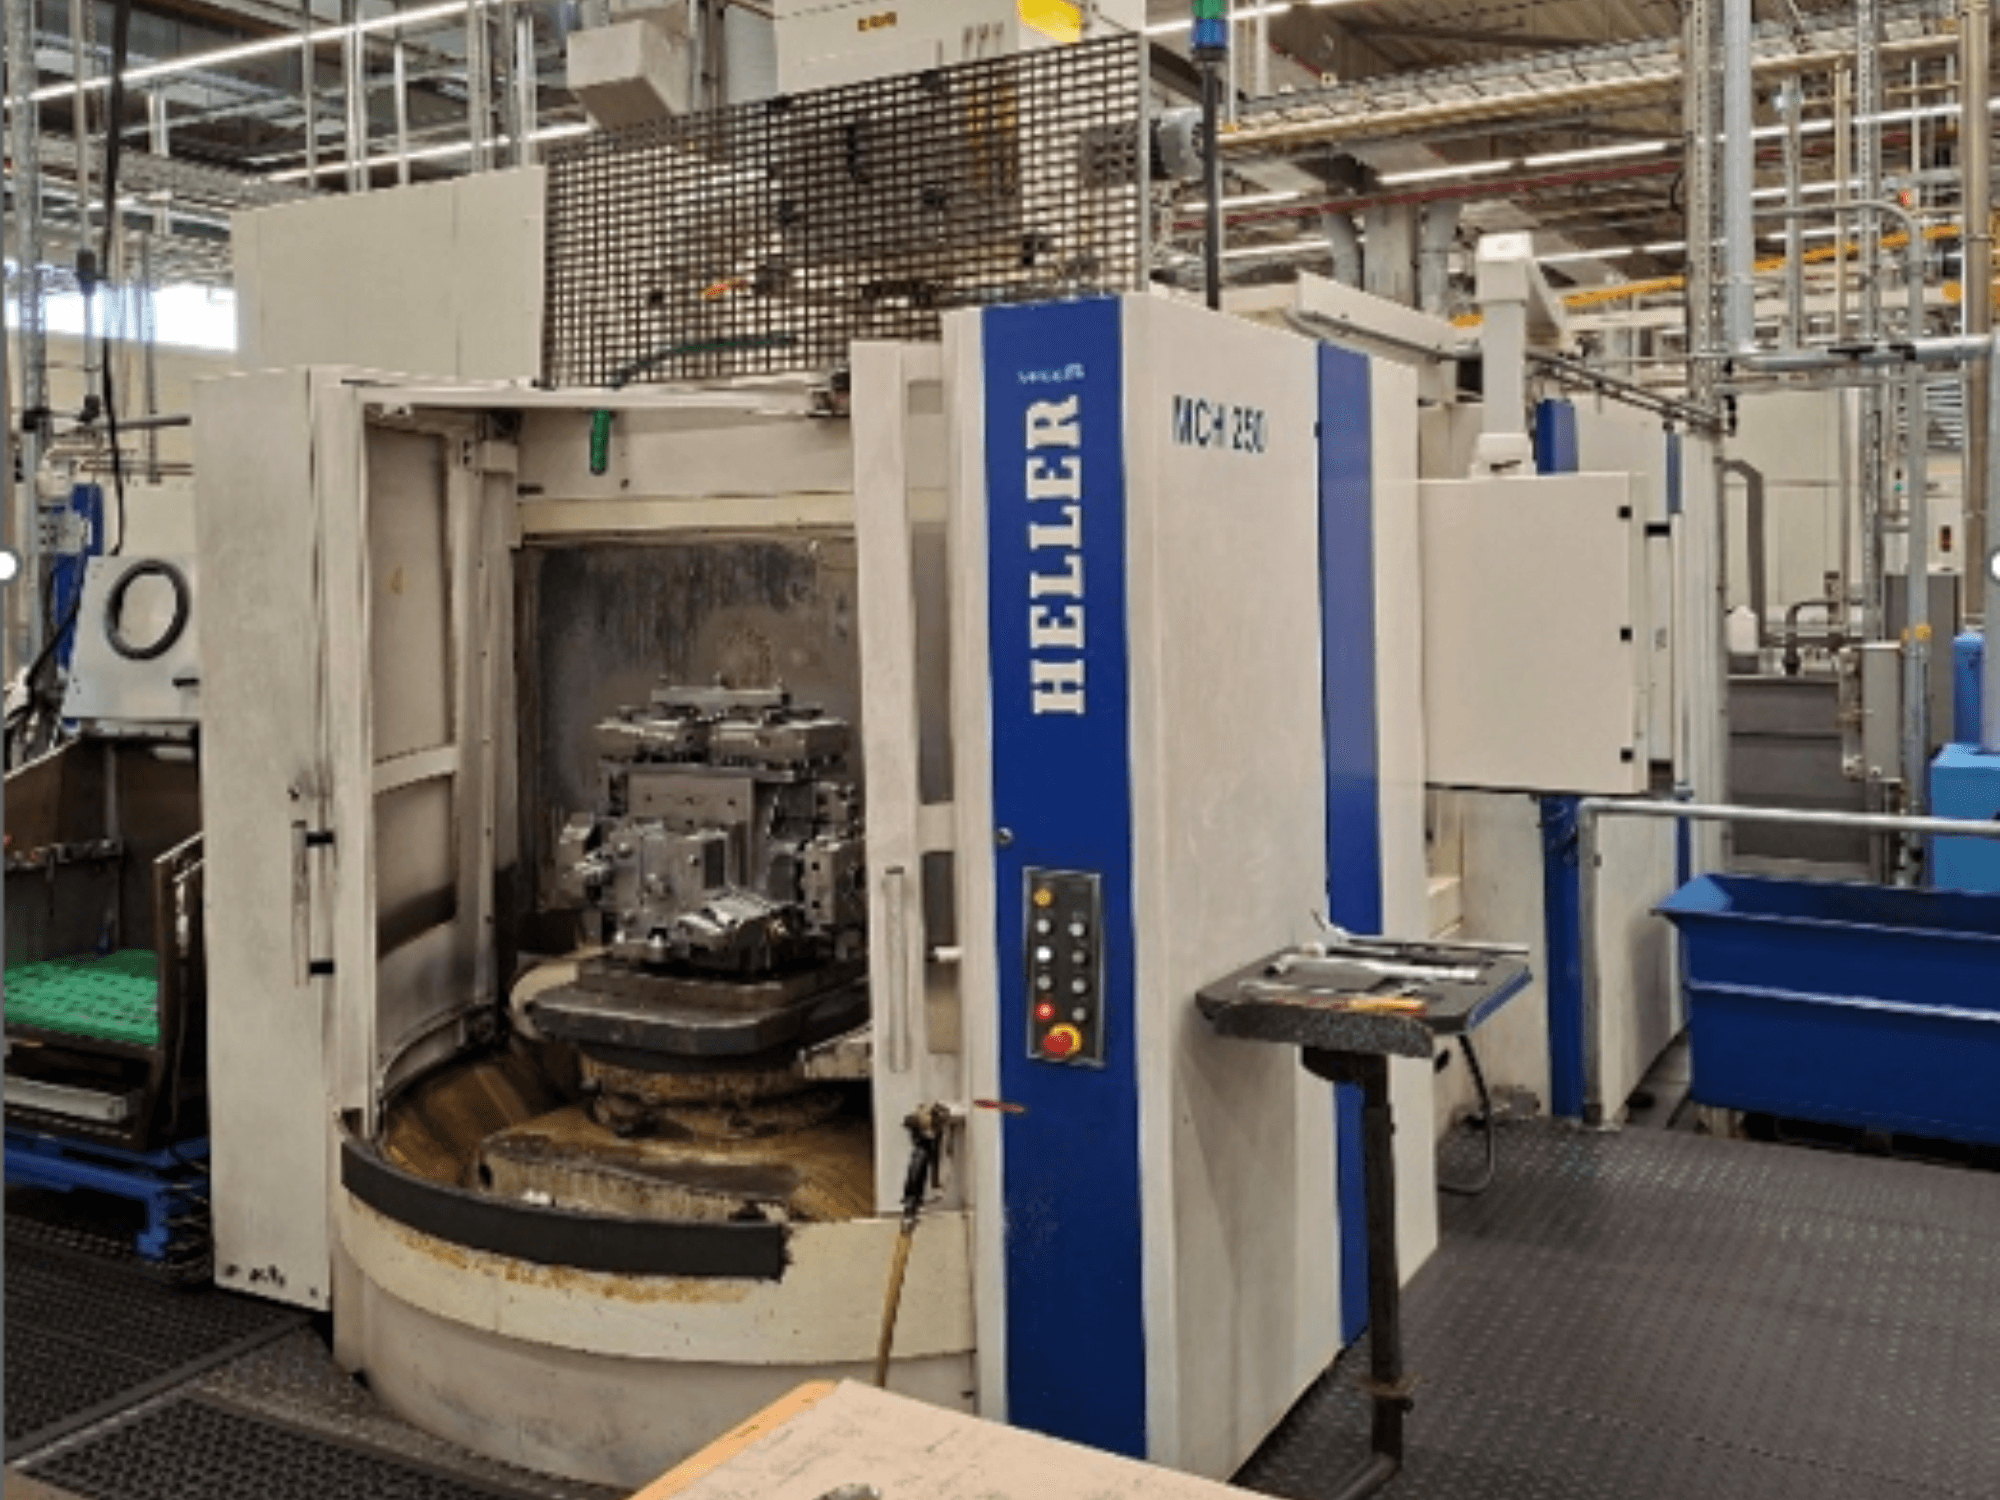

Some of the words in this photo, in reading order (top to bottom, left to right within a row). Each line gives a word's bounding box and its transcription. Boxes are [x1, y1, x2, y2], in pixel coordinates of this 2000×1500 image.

[1172, 394, 1226, 448] MCH
[1232, 405, 1268, 454] 250
[1026, 394, 1086, 715] HELLER
